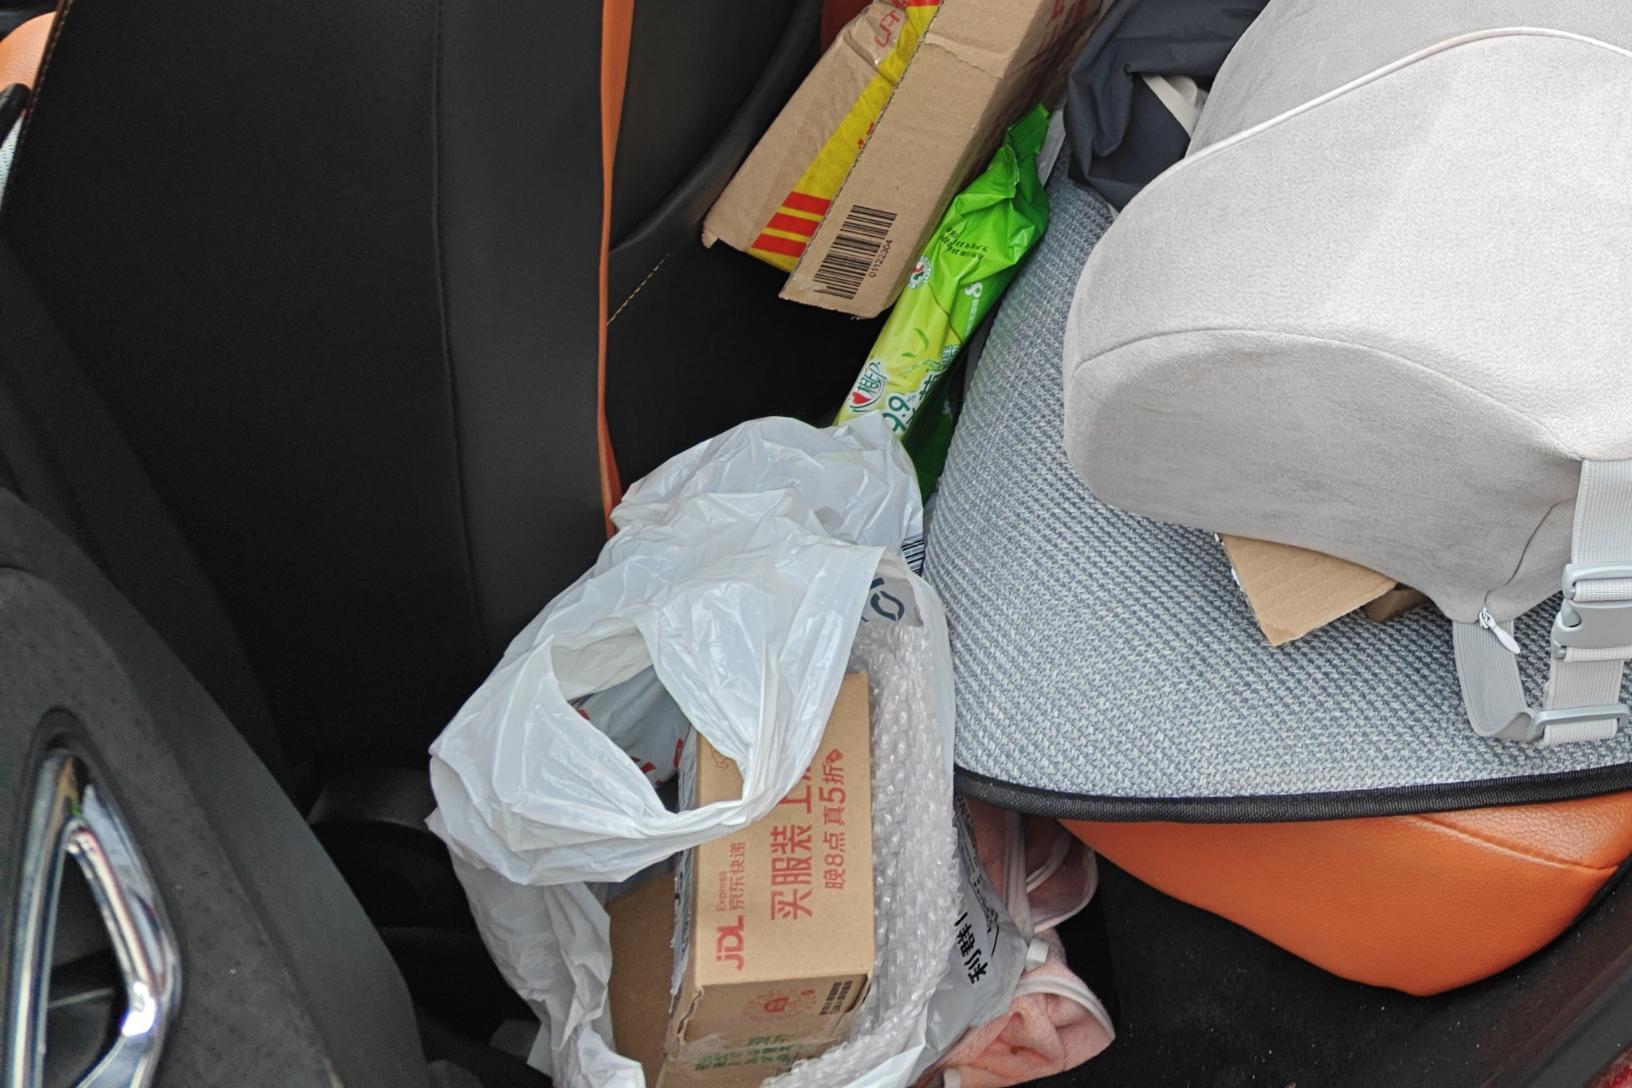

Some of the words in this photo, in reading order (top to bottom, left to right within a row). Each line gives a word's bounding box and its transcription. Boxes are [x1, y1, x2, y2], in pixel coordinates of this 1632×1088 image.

[868, 239, 894, 279] 01122304
[819, 763, 846, 825] 真5折
[716, 870, 728, 912] Express
[729, 841, 747, 912] 京东快递
[770, 824, 813, 921] 买服装
[822, 831, 846, 891] 晚8点
[954, 912, 989, 985] 利群
